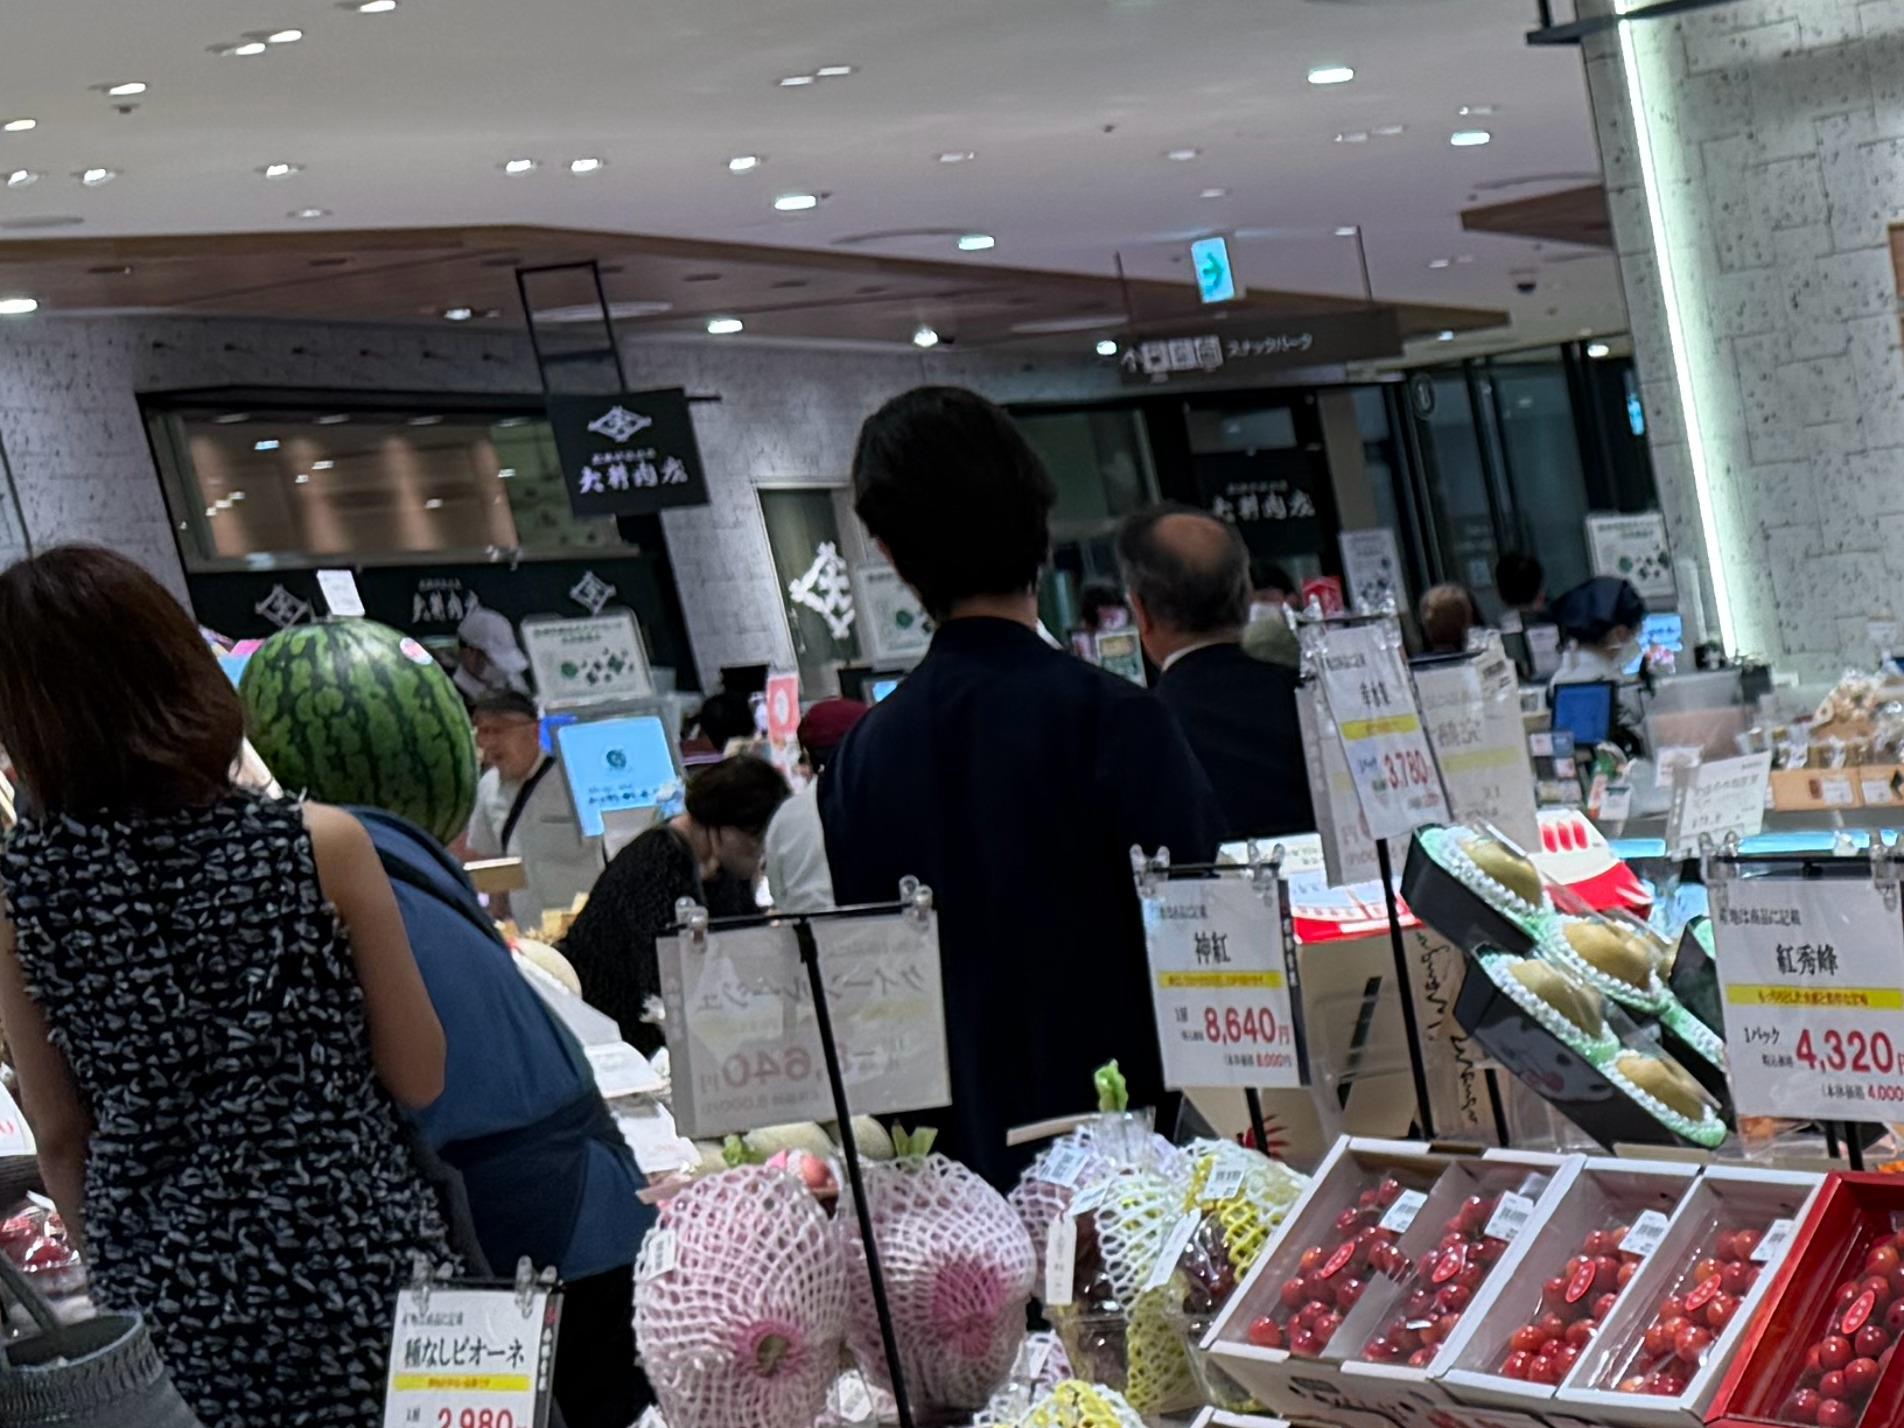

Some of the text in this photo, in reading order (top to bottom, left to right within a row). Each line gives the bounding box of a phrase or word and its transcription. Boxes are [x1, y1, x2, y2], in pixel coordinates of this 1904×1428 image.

[1193, 931, 1231, 966] 神紅
[1776, 944, 1838, 977] 紅秀峰
[1204, 1006, 1290, 1046] 8,640円
[1744, 1026, 1781, 1046] 1パック
[403, 1336, 525, 1368] 種なしピオーネ
